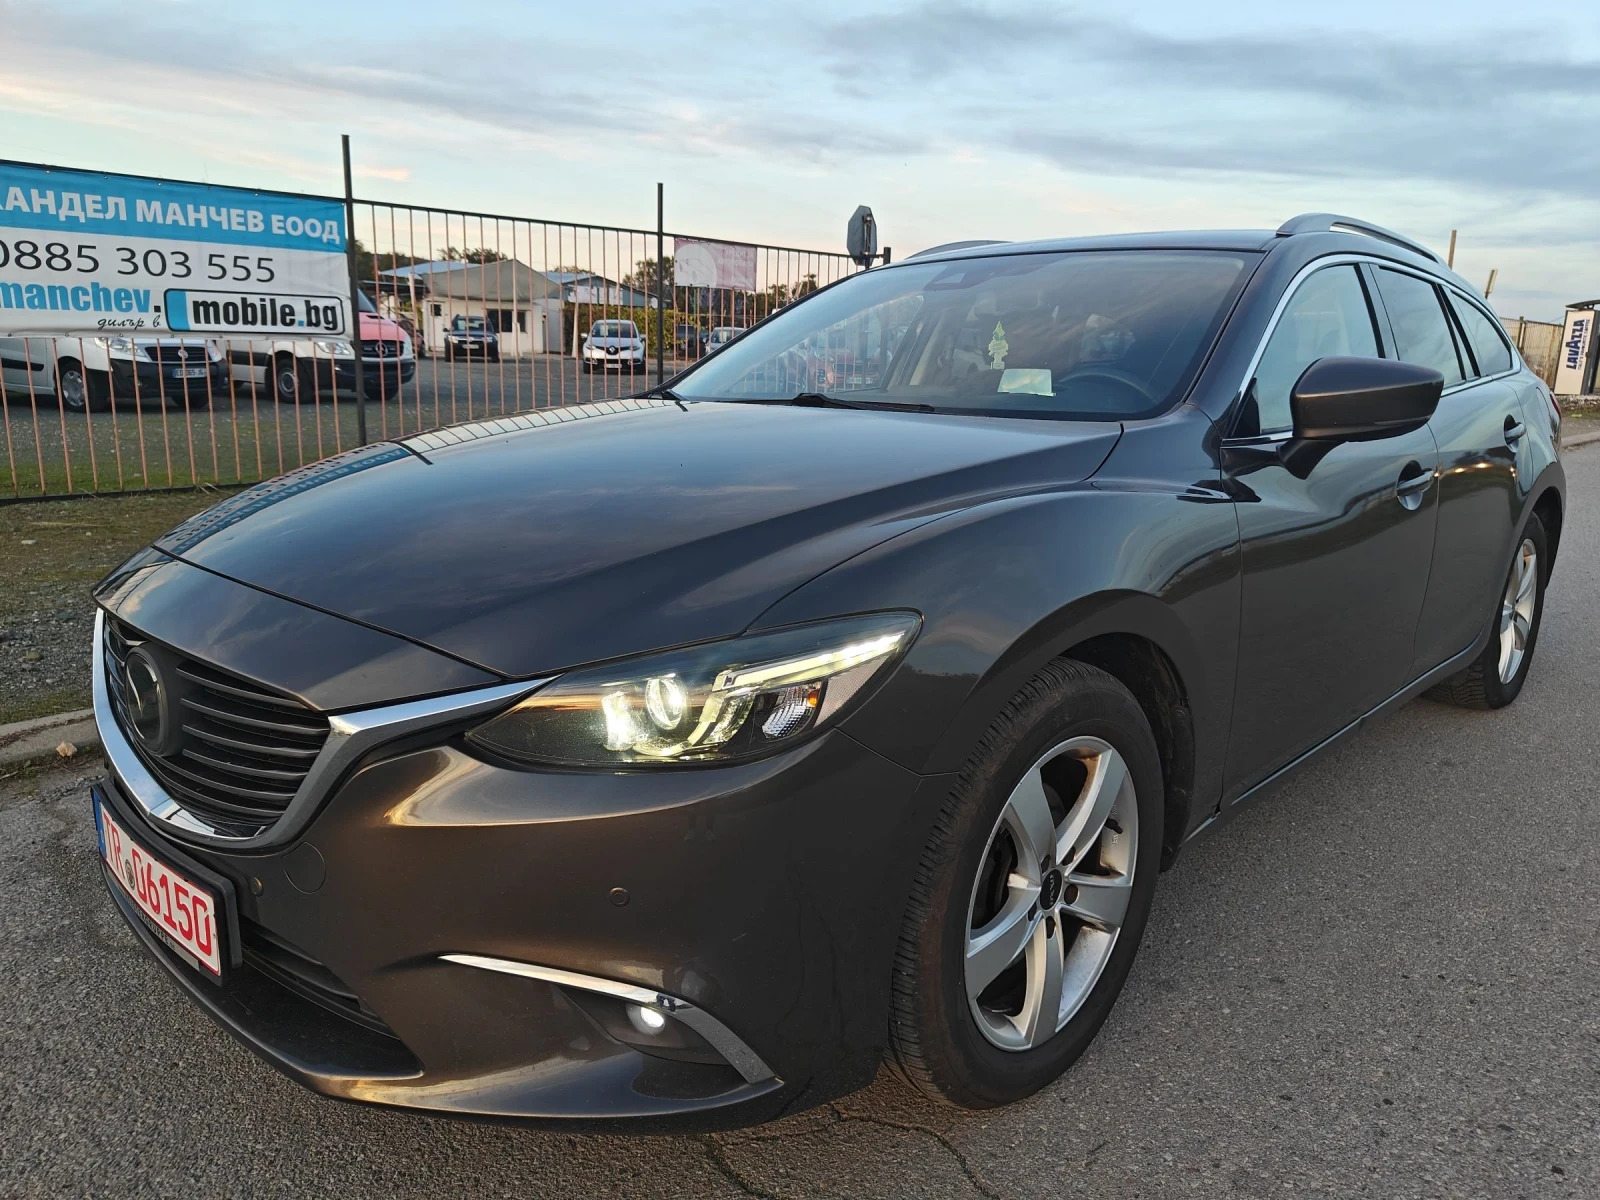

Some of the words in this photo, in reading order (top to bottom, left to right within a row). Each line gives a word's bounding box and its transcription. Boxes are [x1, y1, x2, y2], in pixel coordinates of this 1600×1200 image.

[0, 186, 127, 222] АНДЕЛ
[136, 199, 264, 233] МАНЧЕВ
[271, 214, 340, 245] ЕООД
[116, 247, 192, 278] 303
[207, 253, 275, 283] 555
[192, 297, 338, 331] mobile.bg
[1565, 319, 1585, 370] LAVAZZA
